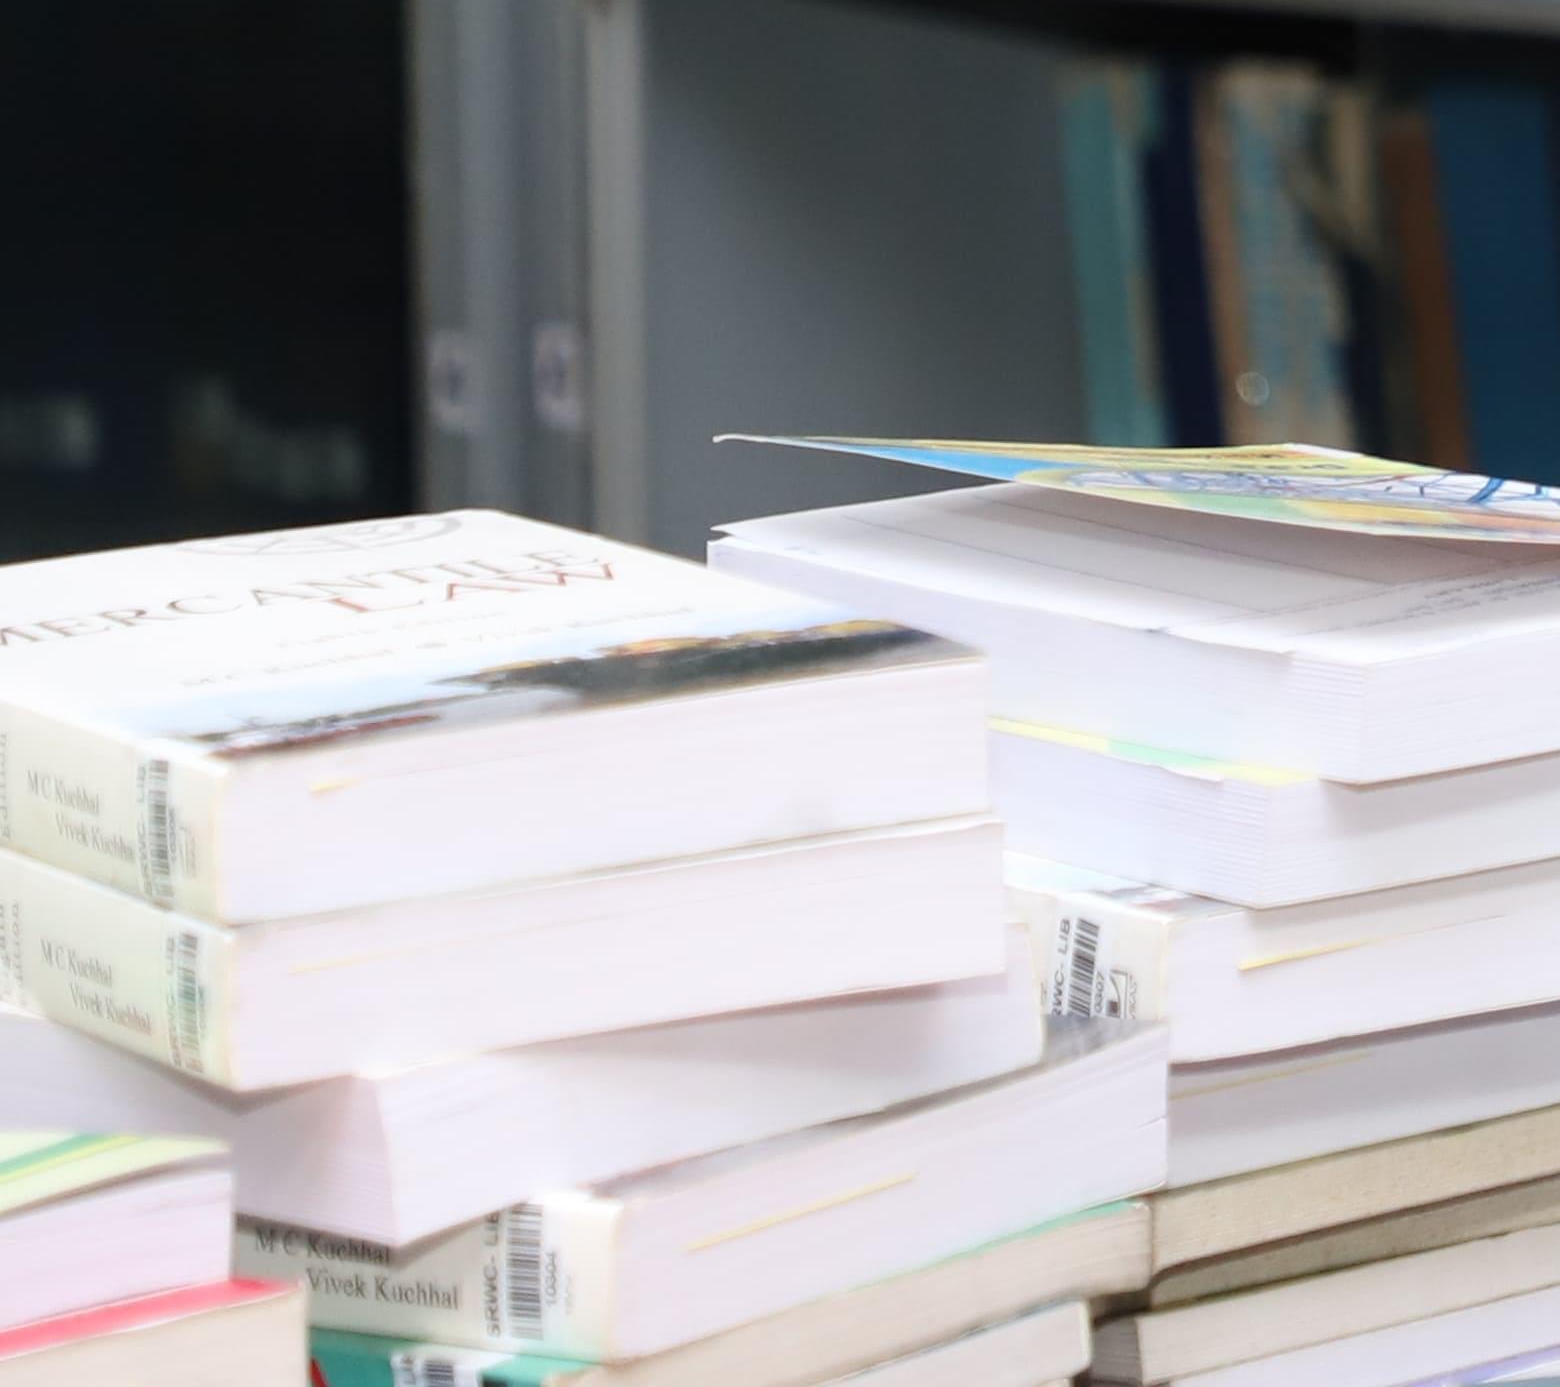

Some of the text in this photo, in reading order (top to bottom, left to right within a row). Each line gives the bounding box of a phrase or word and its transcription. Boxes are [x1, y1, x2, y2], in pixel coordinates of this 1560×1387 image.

[328, 562, 620, 615] LAW
[26, 769, 101, 817] M C Kuchhal
[55, 814, 90, 849] Vivek
[1058, 918, 1071, 956] LIB
[39, 938, 114, 989] M C Kuchhal
[69, 982, 152, 1036] Vivek Kuchhal
[254, 1231, 393, 1267] M C Kuchhal
[305, 1265, 461, 1311] Vivek Kuchhal
[484, 1256, 502, 1338] SRWC-
